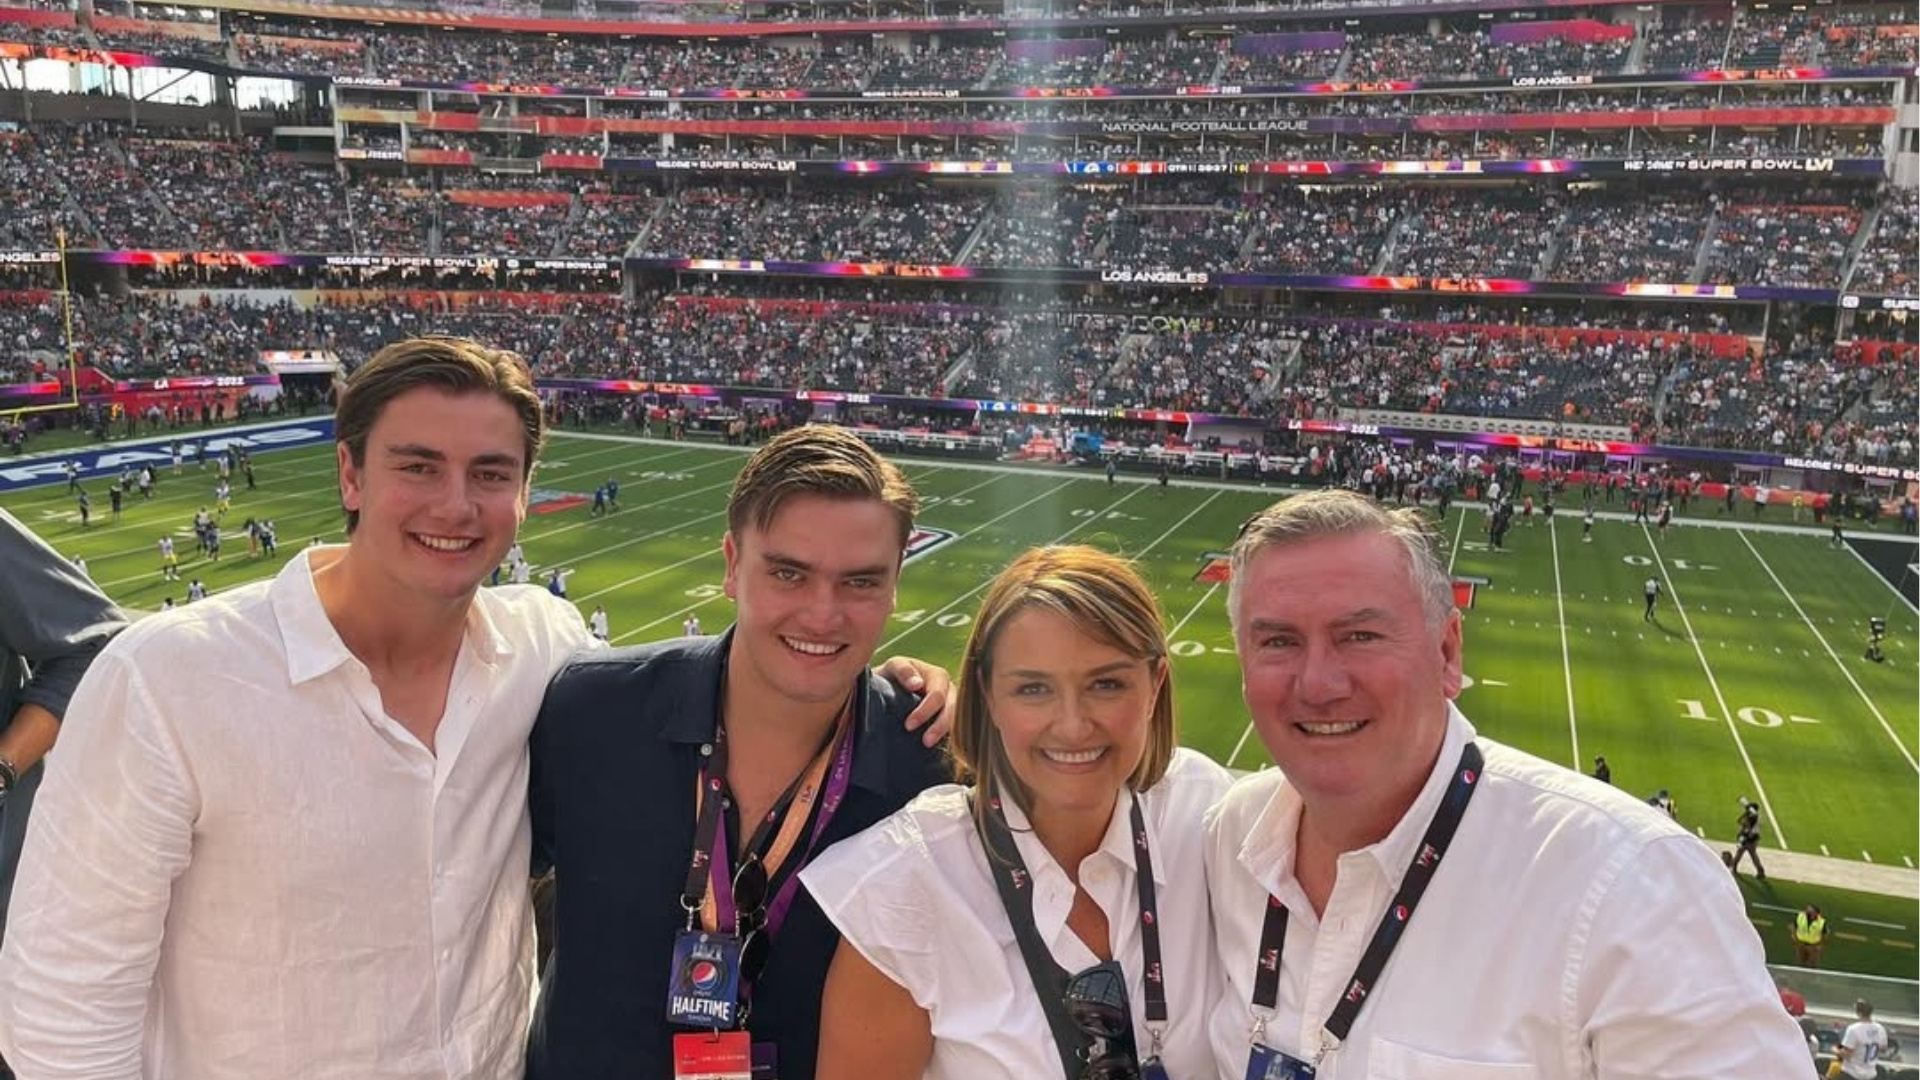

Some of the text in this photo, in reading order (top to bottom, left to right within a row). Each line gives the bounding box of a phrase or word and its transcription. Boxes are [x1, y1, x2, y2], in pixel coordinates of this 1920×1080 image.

[1512, 75, 1593, 86] LOS ANGELES
[1101, 119, 1308, 132] NATIONAL FOOTBALL LEAGUE
[700, 160, 739, 169] SUPER
[741, 161, 777, 170] BOWL
[778, 160, 796, 171] LVI
[1688, 159, 1746, 170] SUPER
[1750, 159, 1803, 170] BOWL
[1805, 157, 1834, 171] LVI
[382, 256, 430, 267] SUPER
[433, 257, 475, 267] BOWL
[476, 257, 498, 269] LVI
[535, 260, 564, 268] SUPER
[1100, 270, 1209, 284] LOS ANGELES
[154, 376, 245, 390] LA 2022
[1288, 420, 1380, 435] LA 2022
[1784, 457, 1831, 470] WELCOME
[1844, 462, 1899, 478] SUPER
[1677, 699, 1784, 728] 10
[672, 996, 731, 1022] HALFTIME
